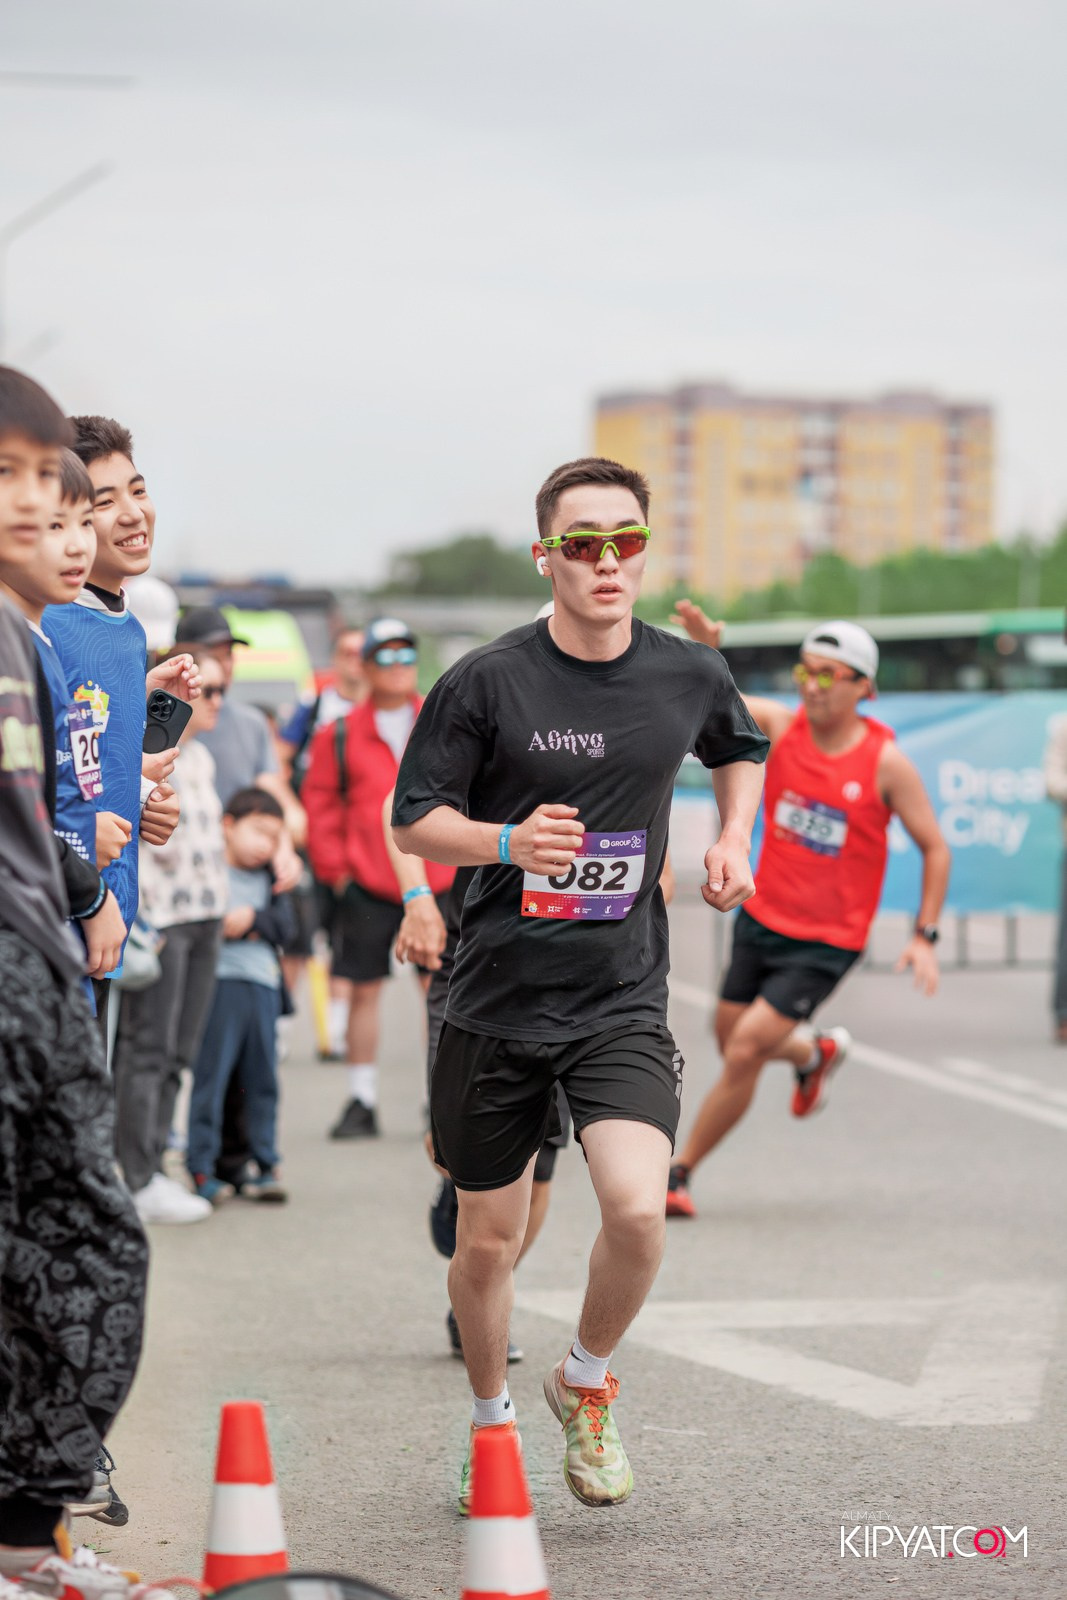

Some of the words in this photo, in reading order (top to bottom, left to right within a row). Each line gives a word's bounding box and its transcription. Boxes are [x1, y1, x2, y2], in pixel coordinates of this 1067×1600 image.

[586, 748, 605, 756] SPORTS
[939, 760, 1047, 804] Drea
[610, 839, 631, 847] GROUP
[547, 860, 629, 891] 082
